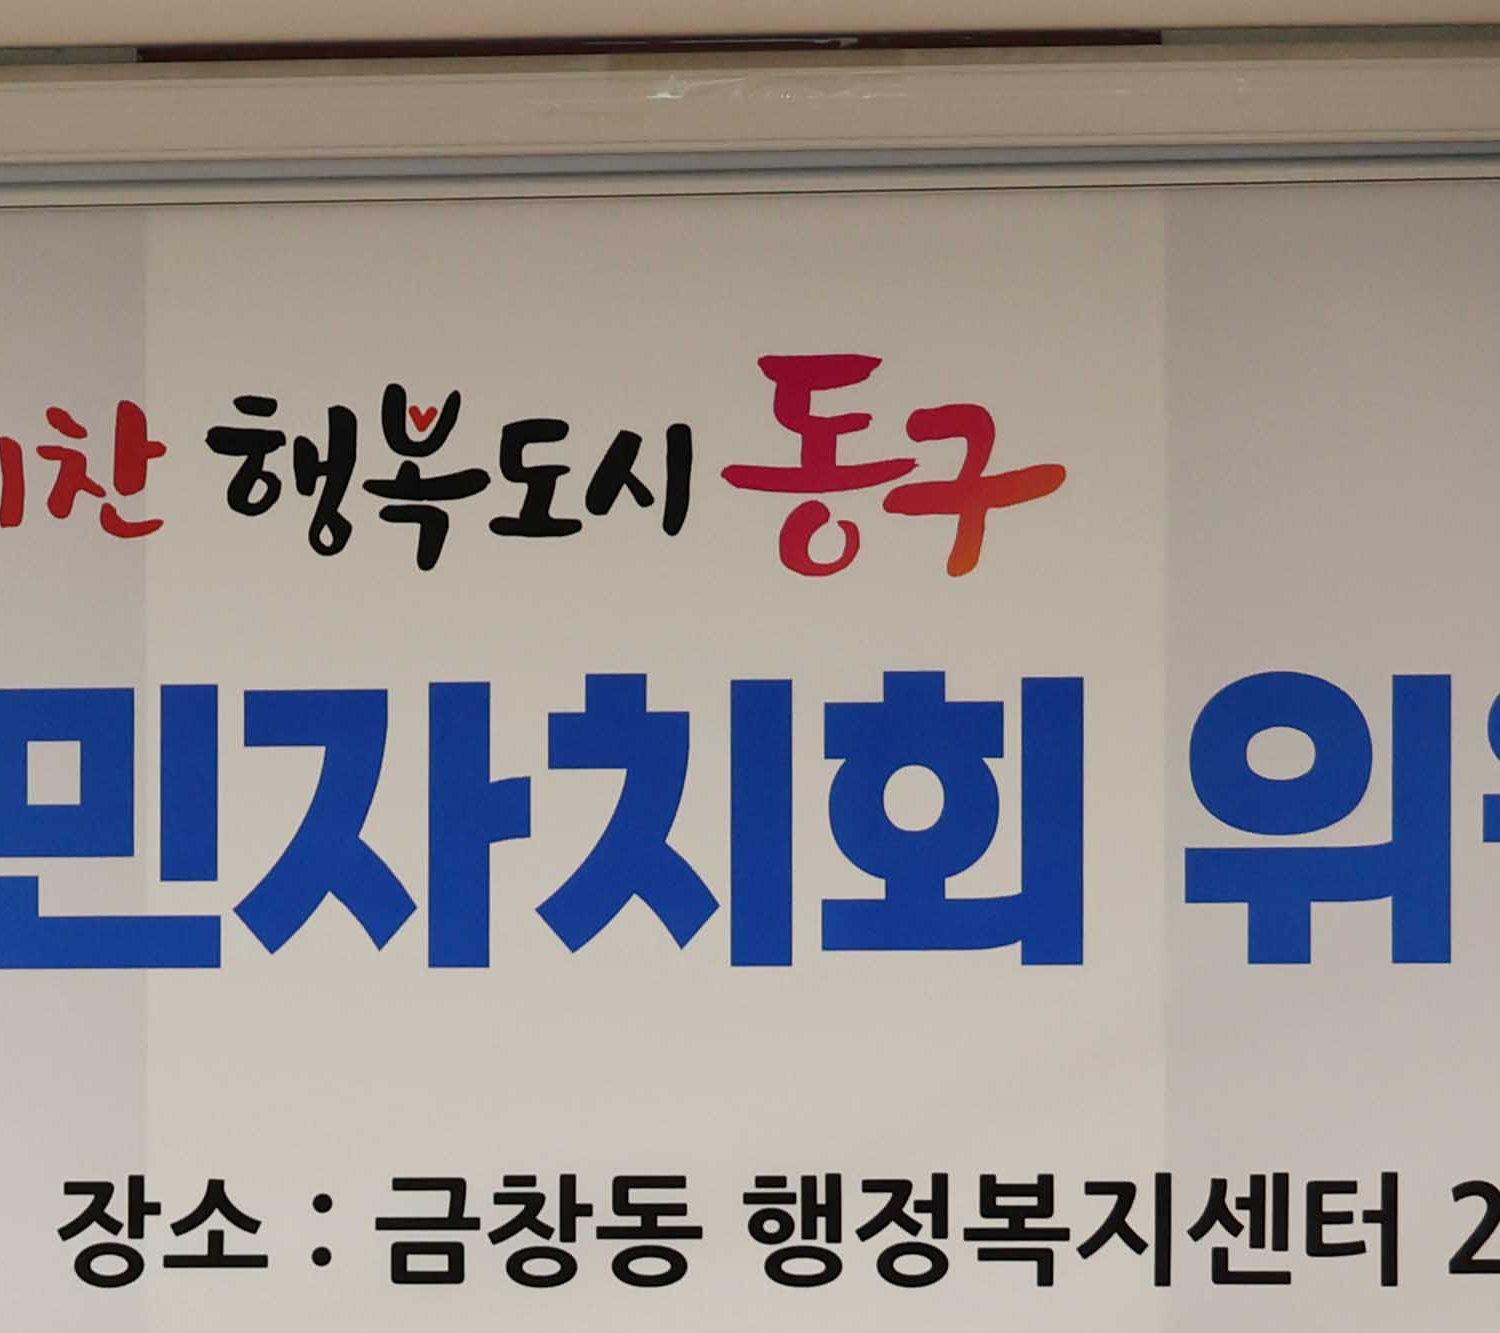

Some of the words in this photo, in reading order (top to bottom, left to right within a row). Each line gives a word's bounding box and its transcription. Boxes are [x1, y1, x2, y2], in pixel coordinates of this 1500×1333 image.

[204, 382, 694, 572] 행복도시
[720, 353, 1068, 578] 동구
[1184, 670, 1500, 966] 위
[56, 1173, 269, 1289] 장소
[310, 1192, 334, 1267] :
[374, 1173, 704, 1289] 금창동
[742, 1171, 1399, 1288] 행정복지센터
